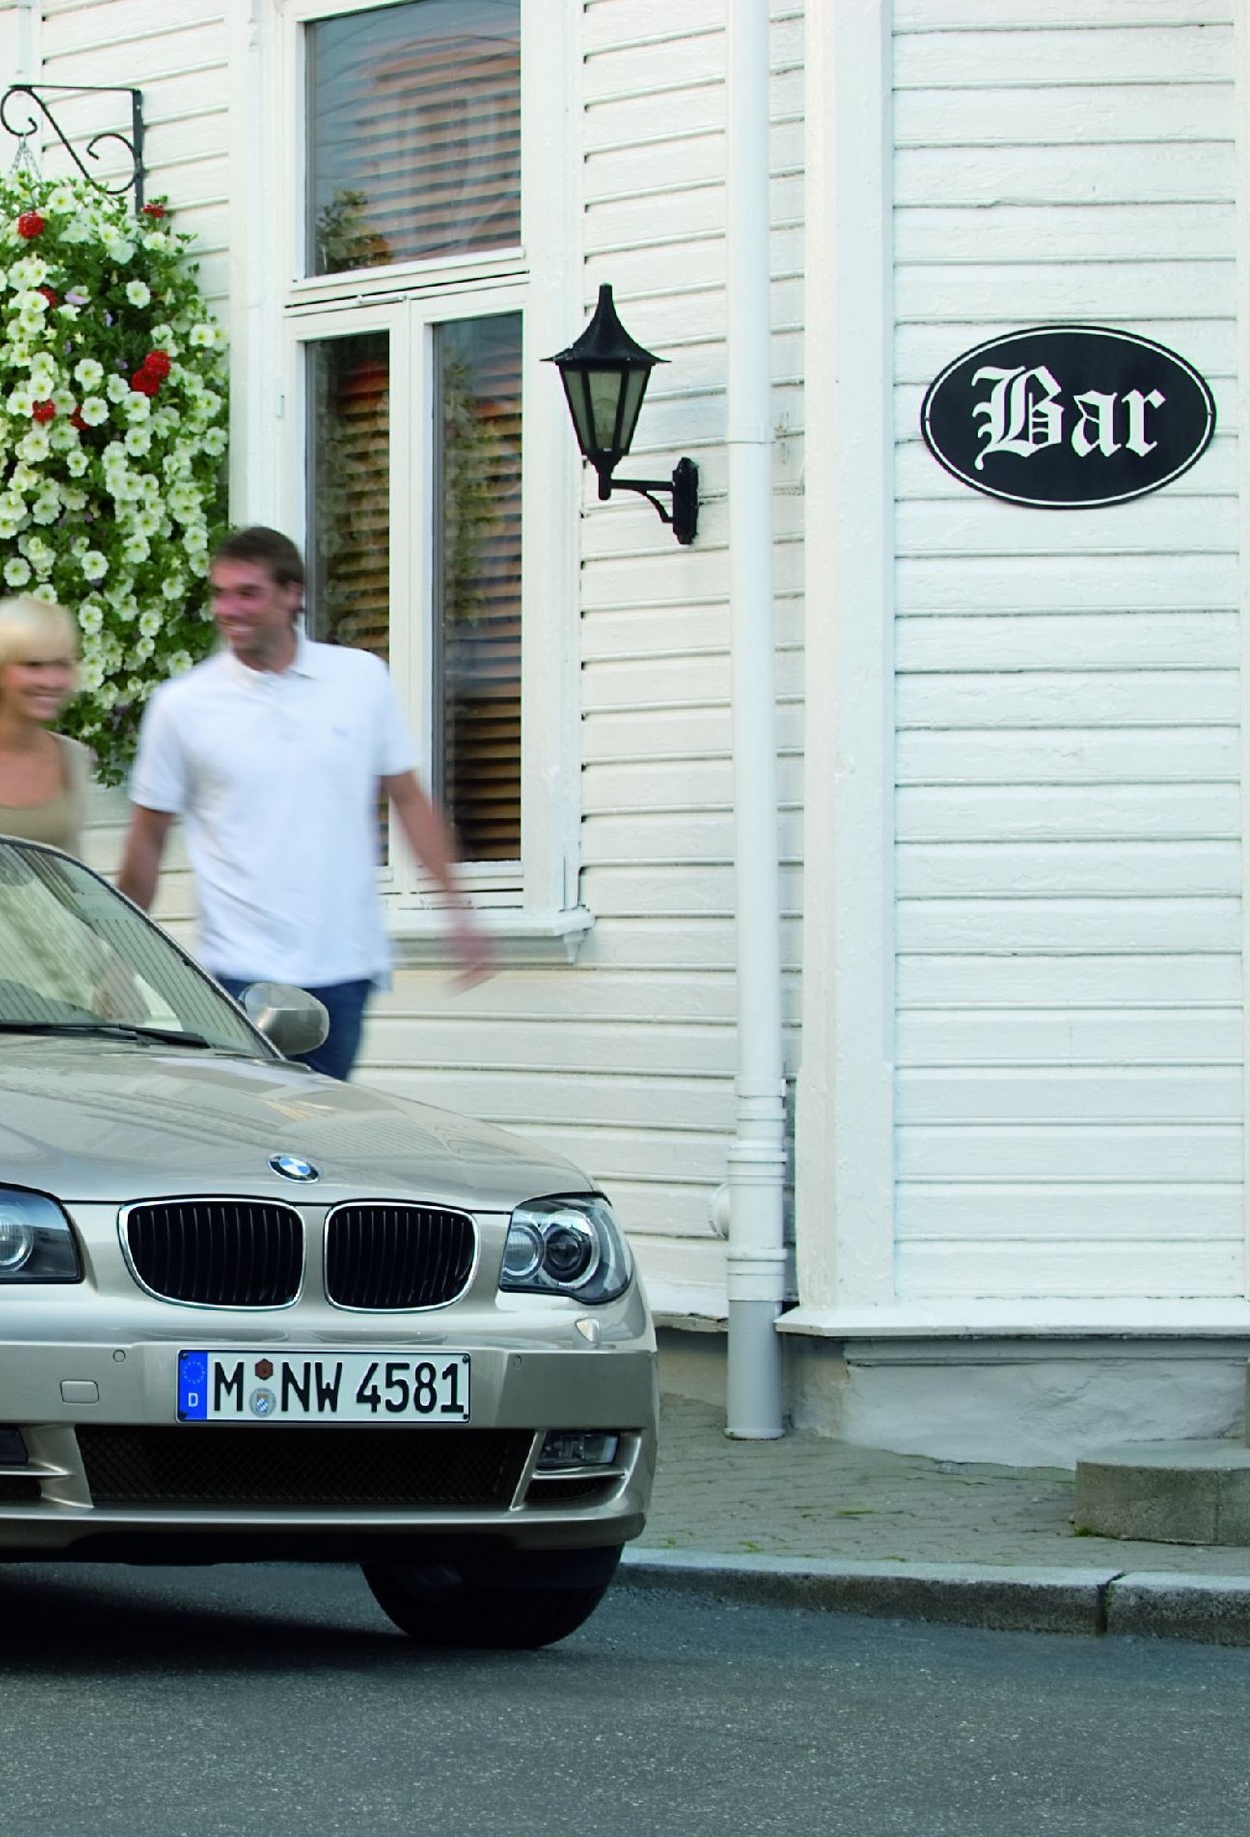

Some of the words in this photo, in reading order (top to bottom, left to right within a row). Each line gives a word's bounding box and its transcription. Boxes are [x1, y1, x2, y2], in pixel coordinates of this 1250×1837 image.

[971, 365, 1166, 471] Bar
[188, 1392, 199, 1407] D
[214, 1361, 244, 1412] M
[281, 1361, 343, 1412] NW
[356, 1361, 465, 1413] 4581
